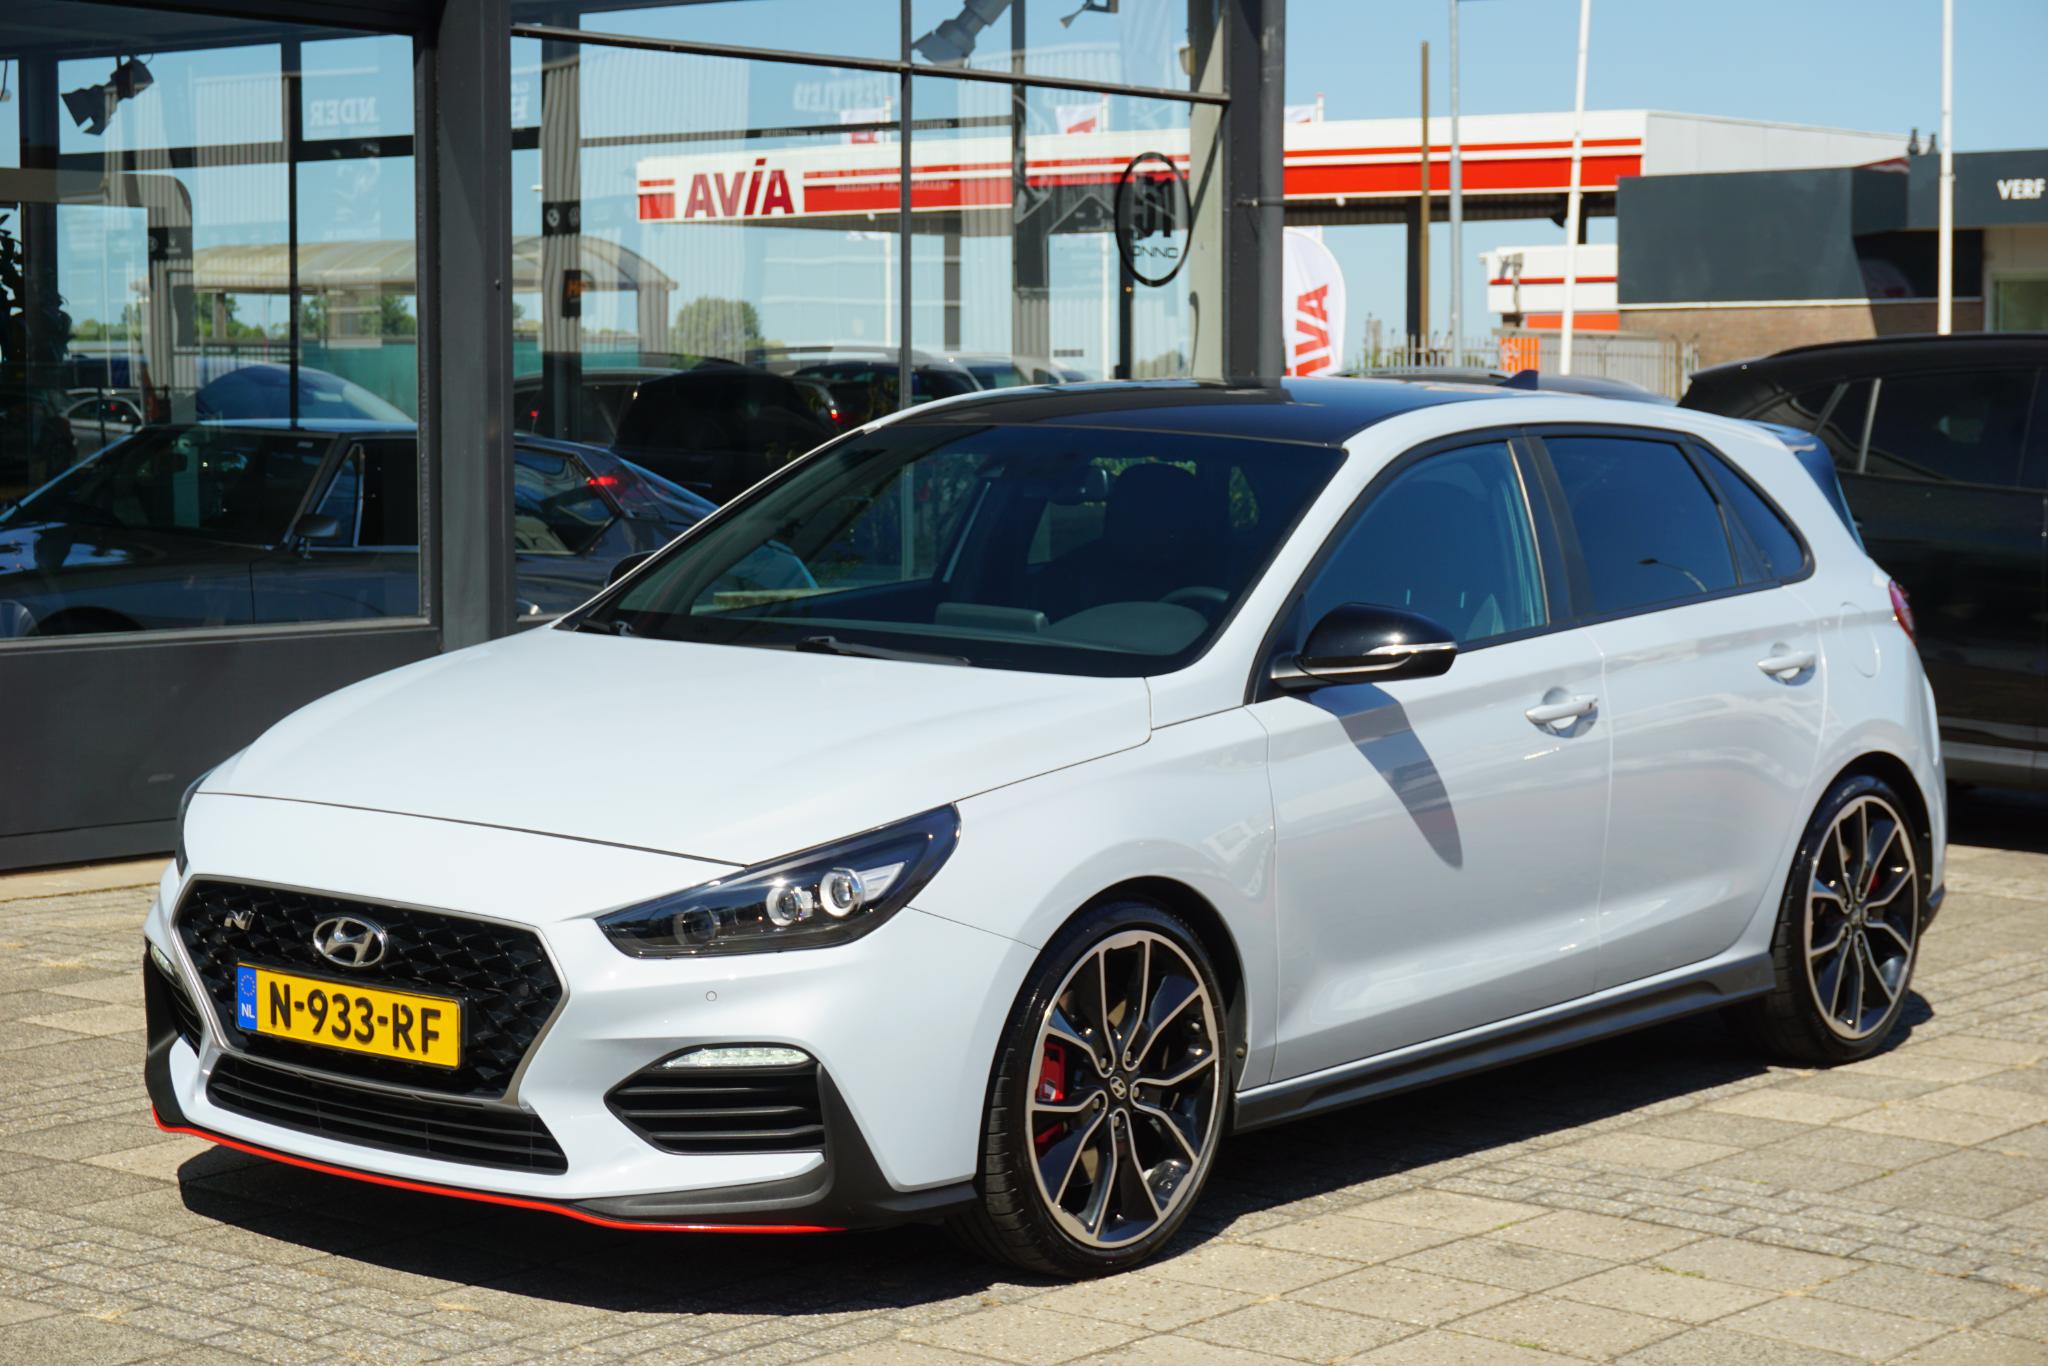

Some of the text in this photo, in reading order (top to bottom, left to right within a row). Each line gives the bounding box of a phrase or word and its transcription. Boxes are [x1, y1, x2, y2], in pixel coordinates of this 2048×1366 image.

[685, 157, 795, 218] AVIA
[1997, 178, 2046, 200] VERF
[241, 1003, 255, 1019] NL
[269, 981, 441, 1054] N-933-RF
